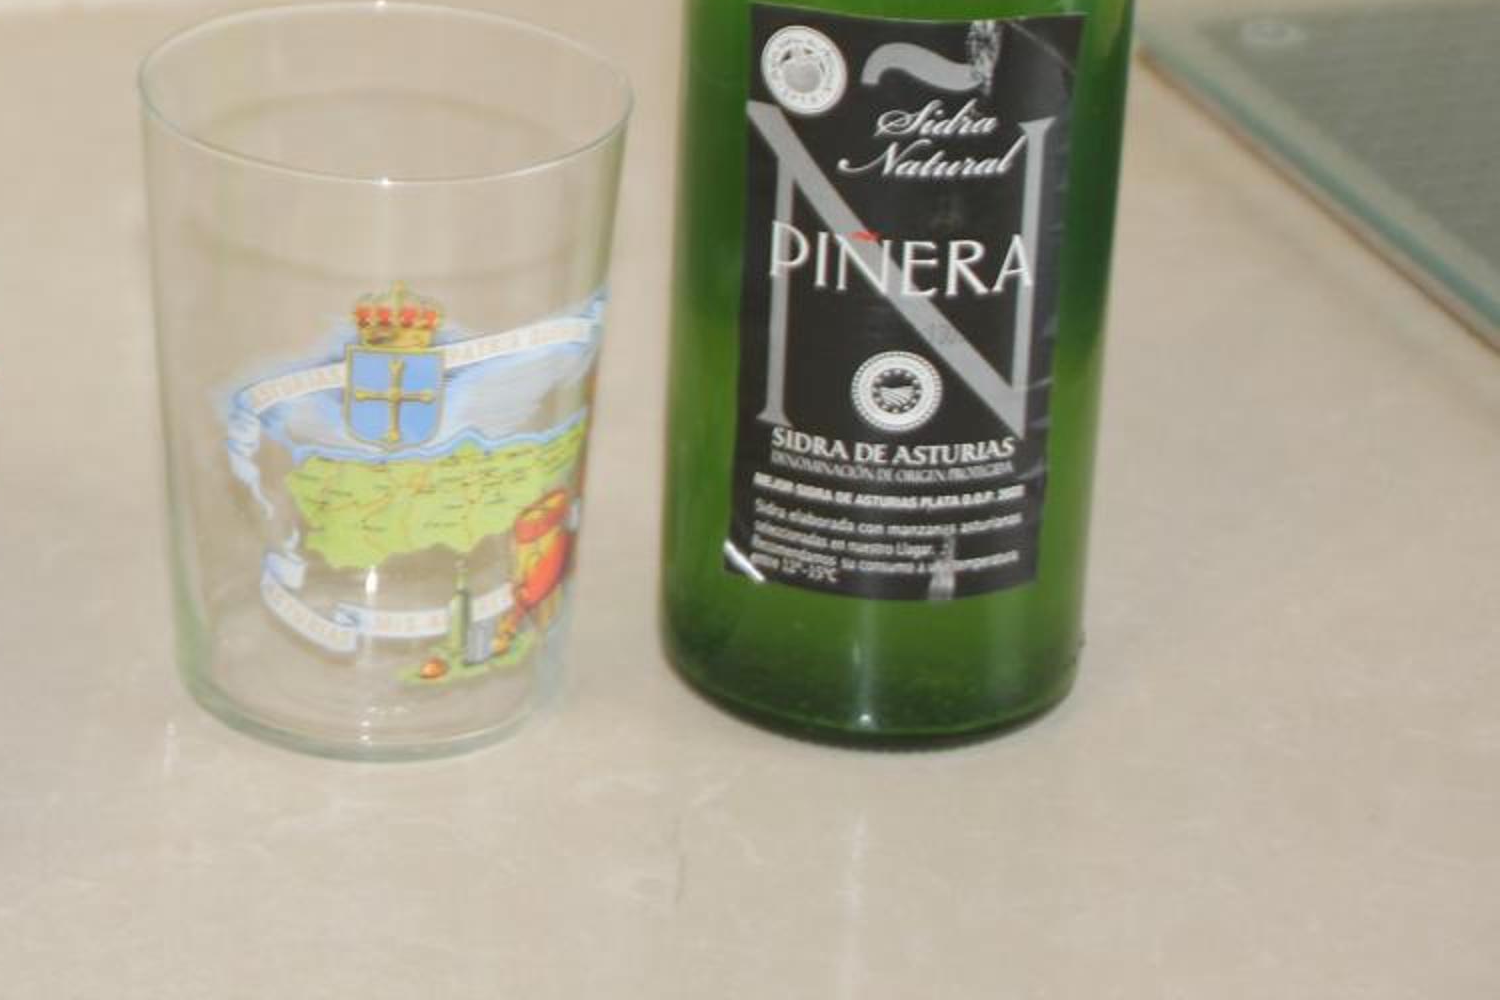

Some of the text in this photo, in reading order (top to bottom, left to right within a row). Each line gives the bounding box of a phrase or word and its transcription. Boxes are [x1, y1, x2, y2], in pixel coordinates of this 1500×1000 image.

[873, 98, 998, 137] Sidra
[837, 134, 1028, 178] Natural
[772, 427, 1015, 466] SIDRA DE ASTURIAS
[853, 493, 918, 509] ASTURIAS
[788, 509, 856, 533] elaborada
[857, 522, 885, 536] con
